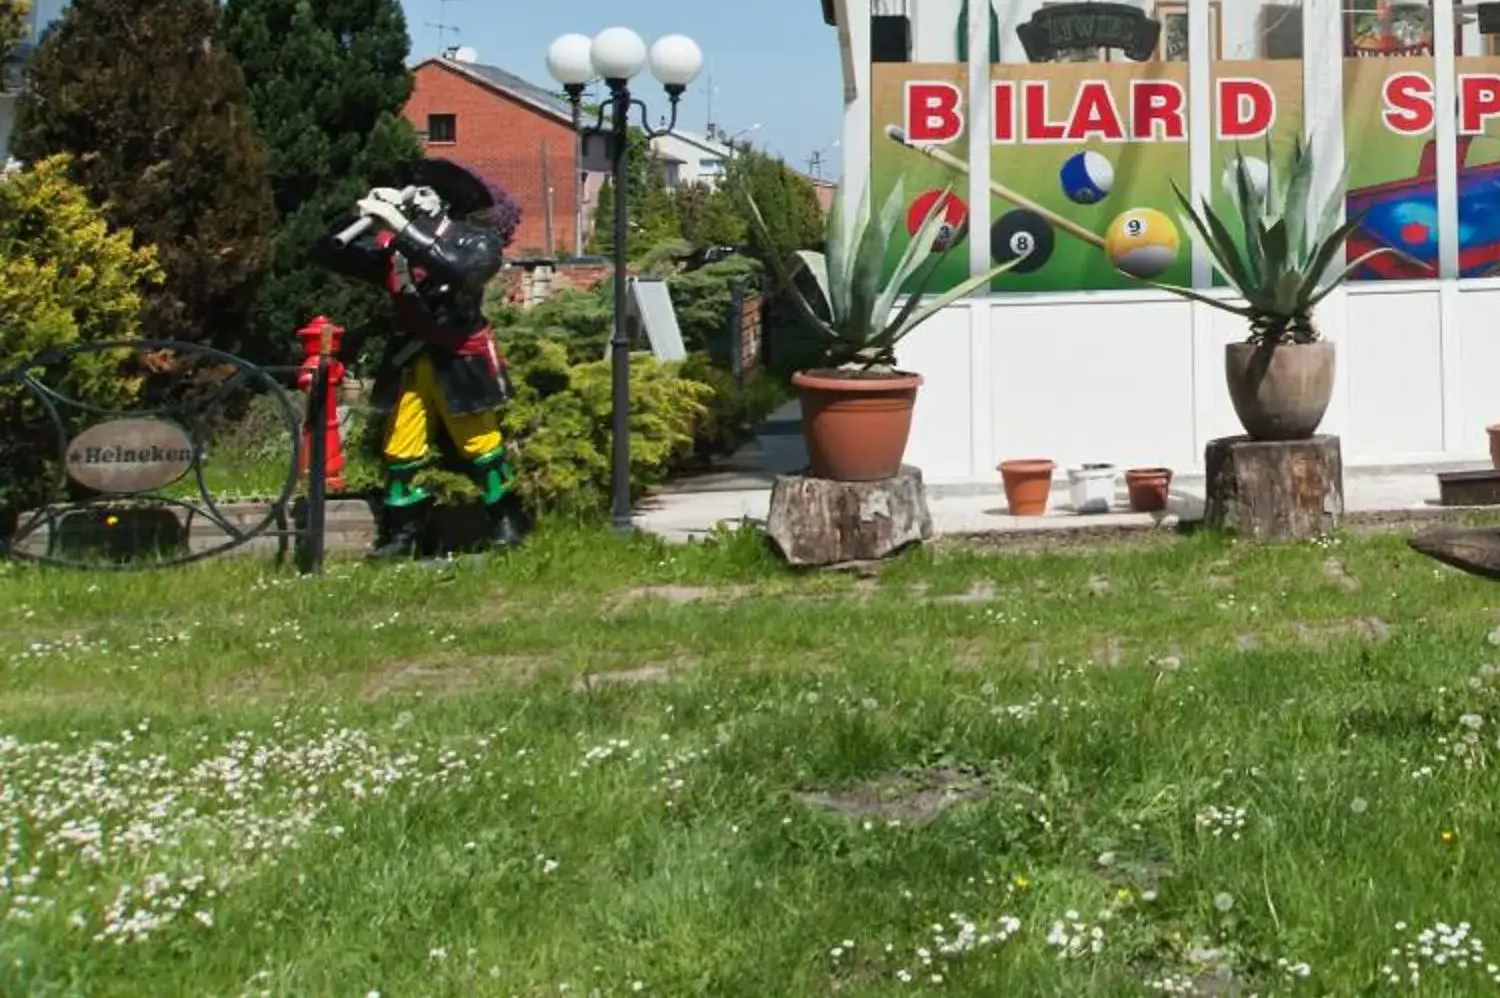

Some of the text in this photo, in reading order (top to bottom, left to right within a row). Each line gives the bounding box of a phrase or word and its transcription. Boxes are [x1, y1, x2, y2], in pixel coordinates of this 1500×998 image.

[905, 78, 1277, 144] BILARD
[1128, 219, 1141, 235] 9
[1017, 237, 1028, 251] 8
[85, 445, 192, 463] Heineken
